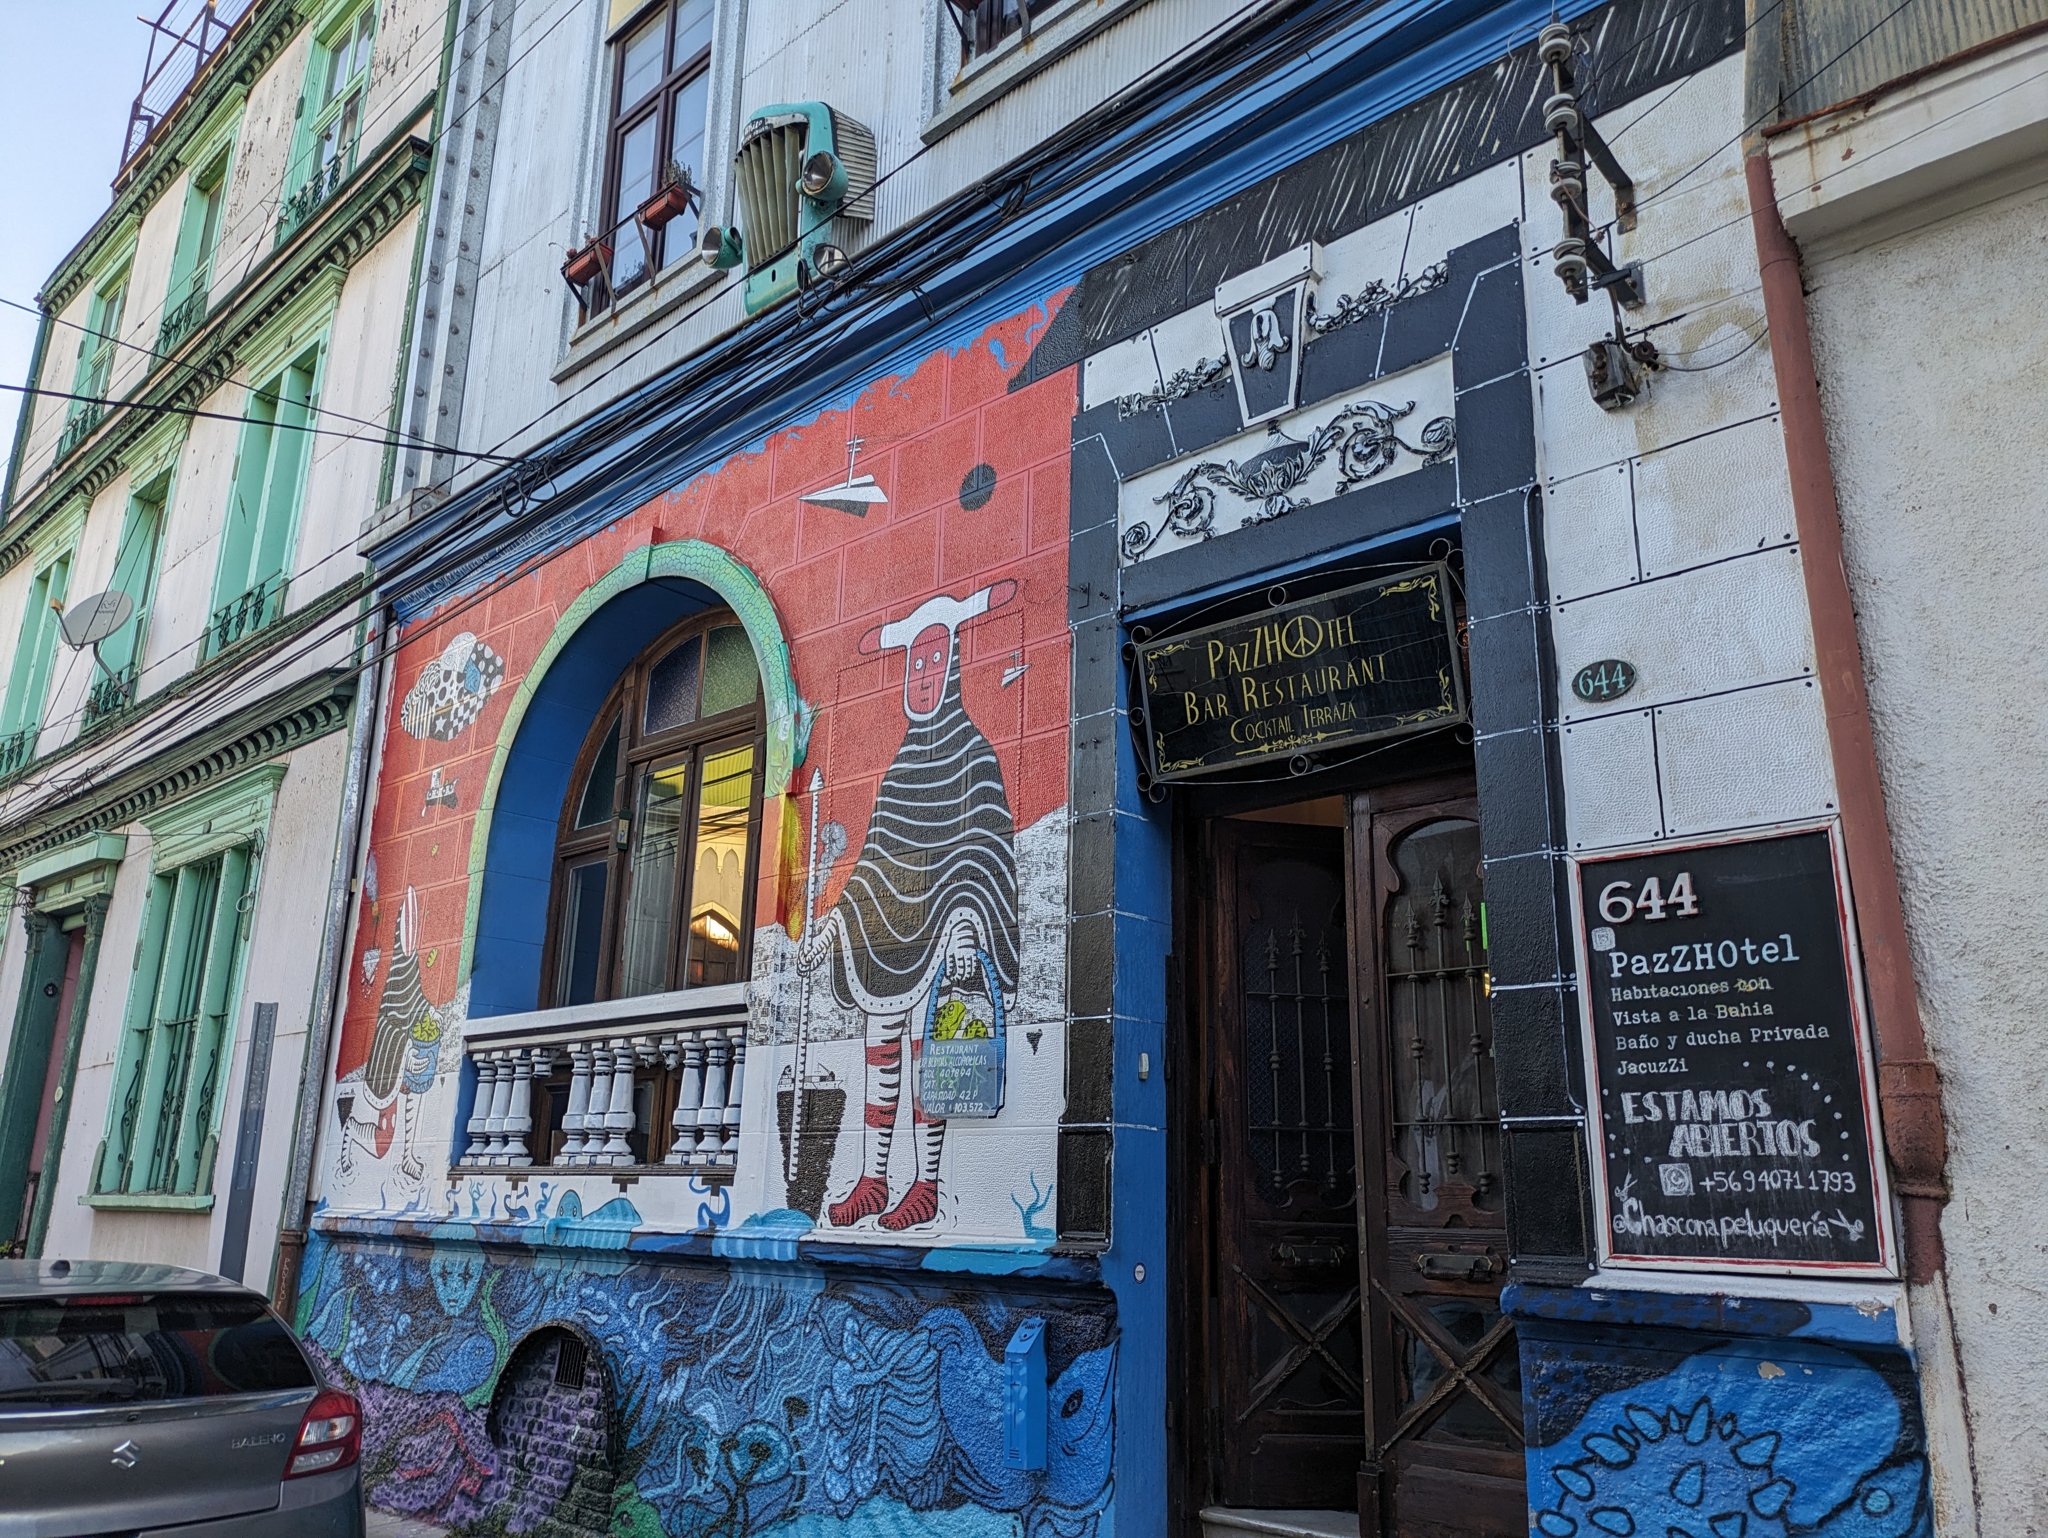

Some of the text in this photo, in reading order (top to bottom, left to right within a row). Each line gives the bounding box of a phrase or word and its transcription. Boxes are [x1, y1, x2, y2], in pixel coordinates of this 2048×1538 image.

[1184, 655, 1386, 725] BAR RESTAURANT
[1578, 663, 1627, 697] 644
[1301, 702, 1357, 729] TERRAZA
[1598, 872, 1700, 924] 644
[1608, 933, 1801, 979] PazZHOtel
[1610, 976, 1773, 1002] Habitaciones con
[1612, 1008, 1662, 1027] Vista
[1669, 1010, 1680, 1022] a
[1687, 1006, 1708, 1021] la
[929, 1043, 979, 1056] RESTAURANT
[1615, 1023, 1830, 1051] Baño y ducha Privada
[923, 1102, 946, 1114] VALOR
[1619, 1088, 1773, 1124] ESTAMOS
[1667, 1118, 1822, 1158] ABIERTOS
[231, 1432, 286, 1450] BALENO
